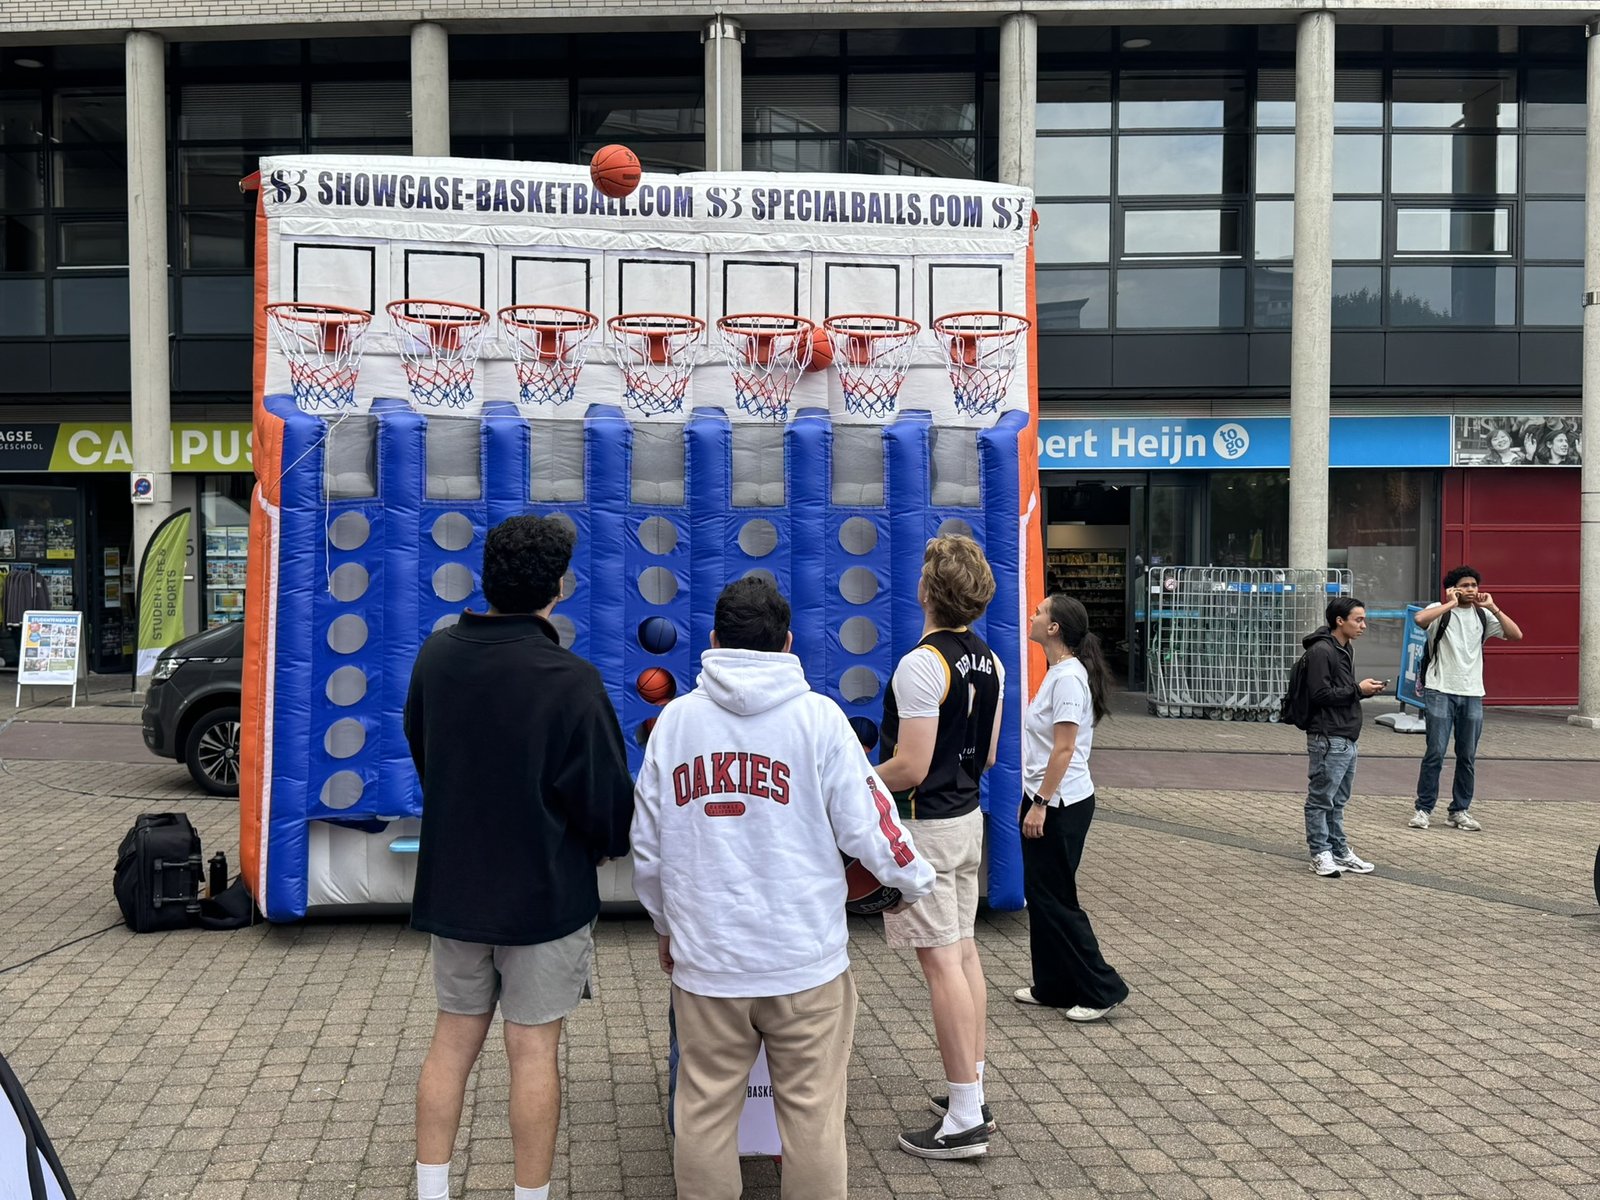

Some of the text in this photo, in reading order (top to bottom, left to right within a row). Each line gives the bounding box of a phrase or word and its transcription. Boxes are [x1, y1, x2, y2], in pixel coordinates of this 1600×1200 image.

[317, 171, 693, 217] SHOWCASE-BASKETBALL.COM
[751, 188, 983, 228] SPECIALBALLS.COM
[68, 430, 253, 466] CAPU
[1111, 425, 1206, 465] Heijn
[1220, 428, 1238, 443] to
[1226, 437, 1245, 456] go
[167, 569, 177, 617] SPORTS
[673, 752, 790, 807] OAKIES
